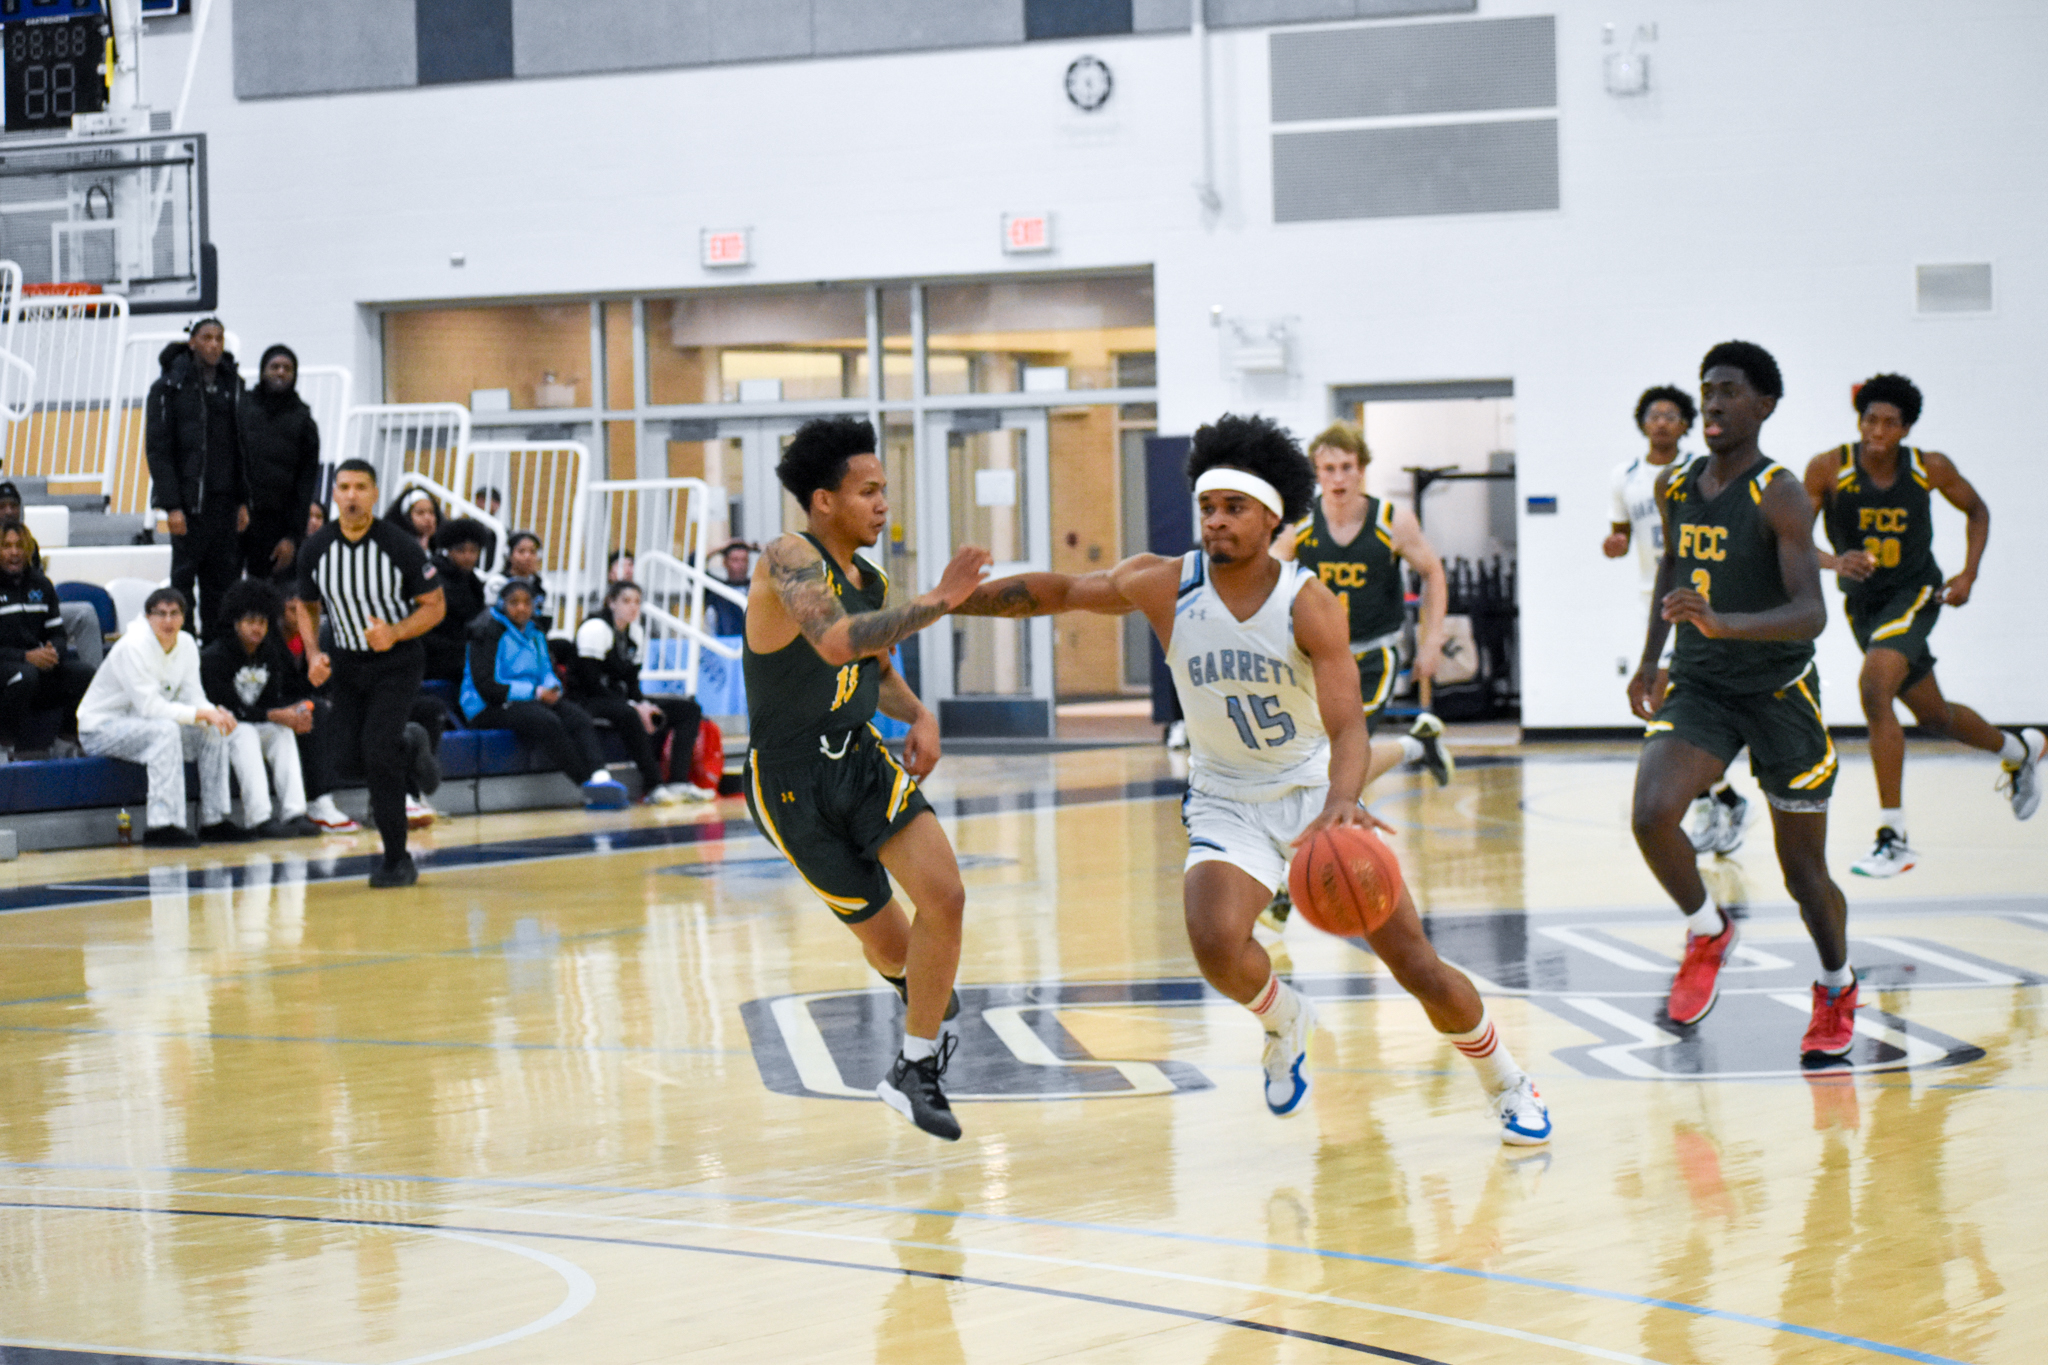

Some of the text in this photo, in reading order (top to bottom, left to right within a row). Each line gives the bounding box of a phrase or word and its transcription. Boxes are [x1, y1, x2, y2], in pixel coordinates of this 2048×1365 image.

[1859, 507, 1908, 533] FCC
[1679, 523, 1729, 562] FCC
[1318, 561, 1368, 588] FCC
[1188, 649, 1296, 687] GARRETT
[1225, 694, 1296, 750] 15
